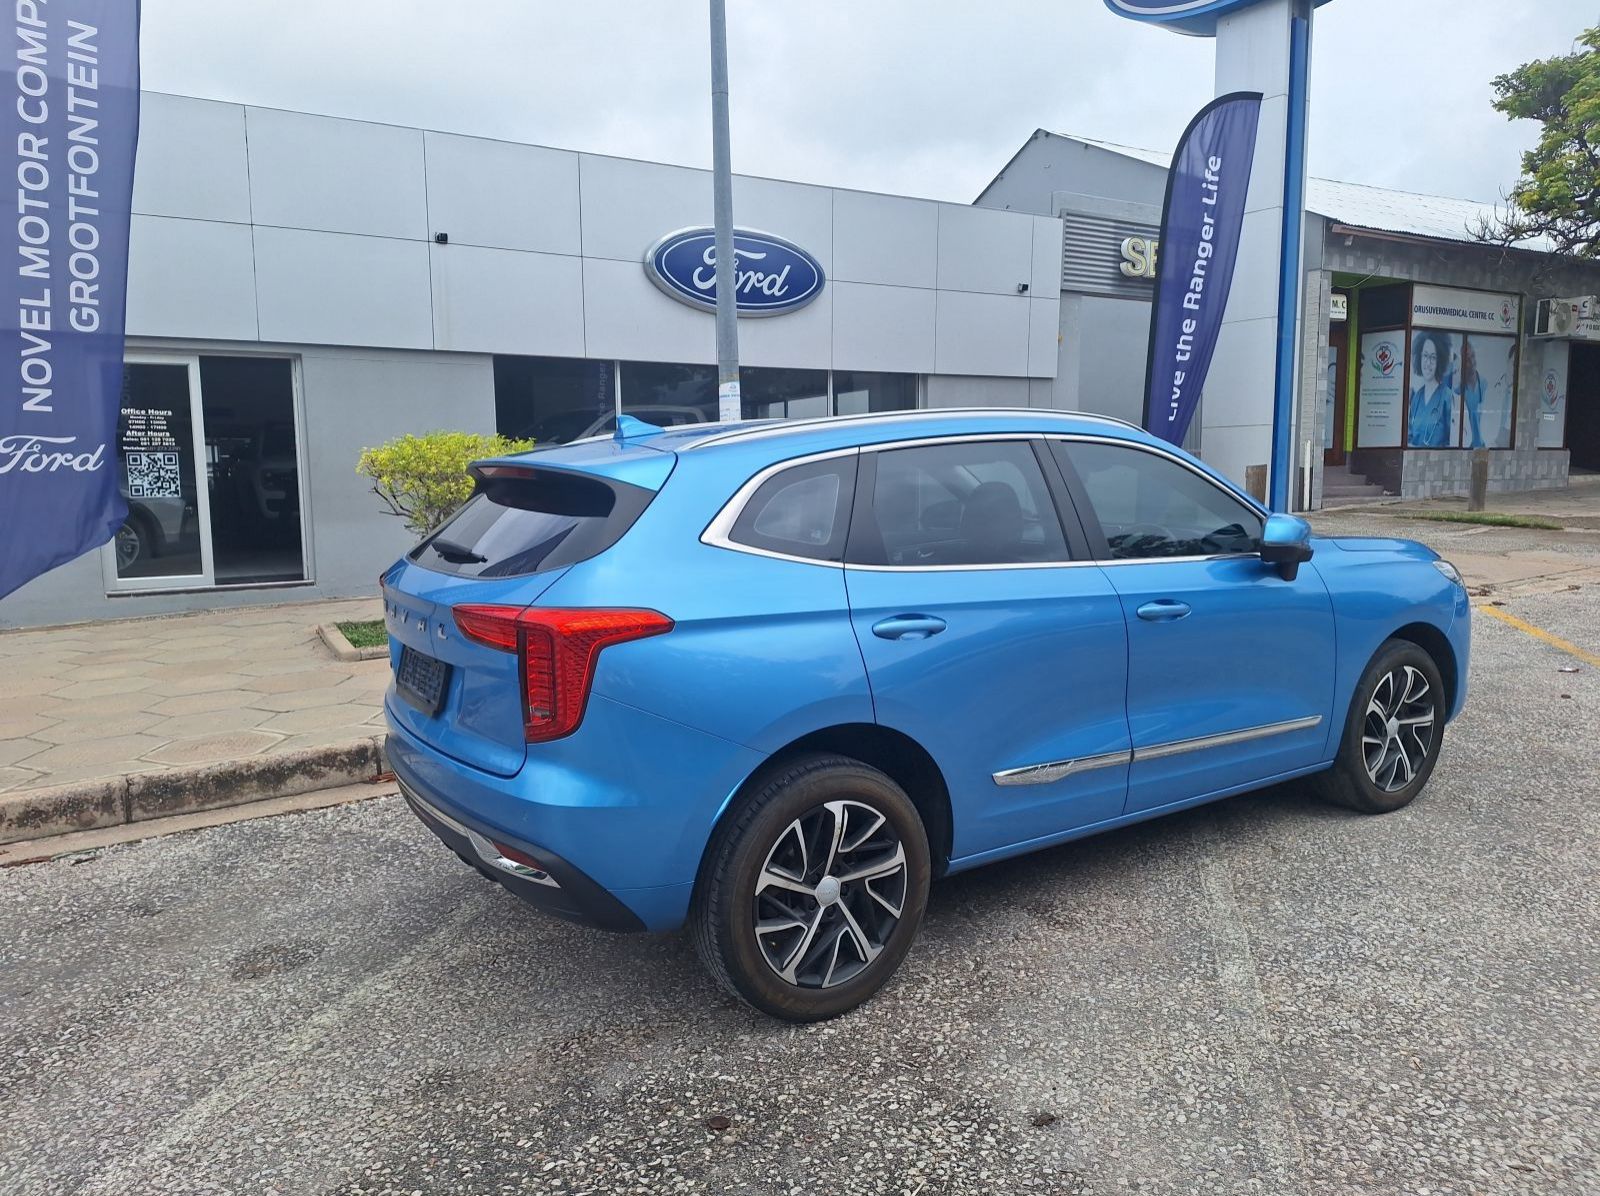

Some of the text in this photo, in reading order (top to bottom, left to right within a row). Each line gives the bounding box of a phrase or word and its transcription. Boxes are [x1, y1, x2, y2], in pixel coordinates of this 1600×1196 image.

[67, 20, 100, 333] GROOTFONTEIN
[16, 0, 53, 412] NOVEL MOTOR COMP
[693, 245, 791, 297] Frd
[1168, 155, 1222, 421] Live the Ranger Life
[1468, 310, 1488, 320] CENTRE
[121, 408, 146, 416] Office
[0, 435, 106, 474] Ford
